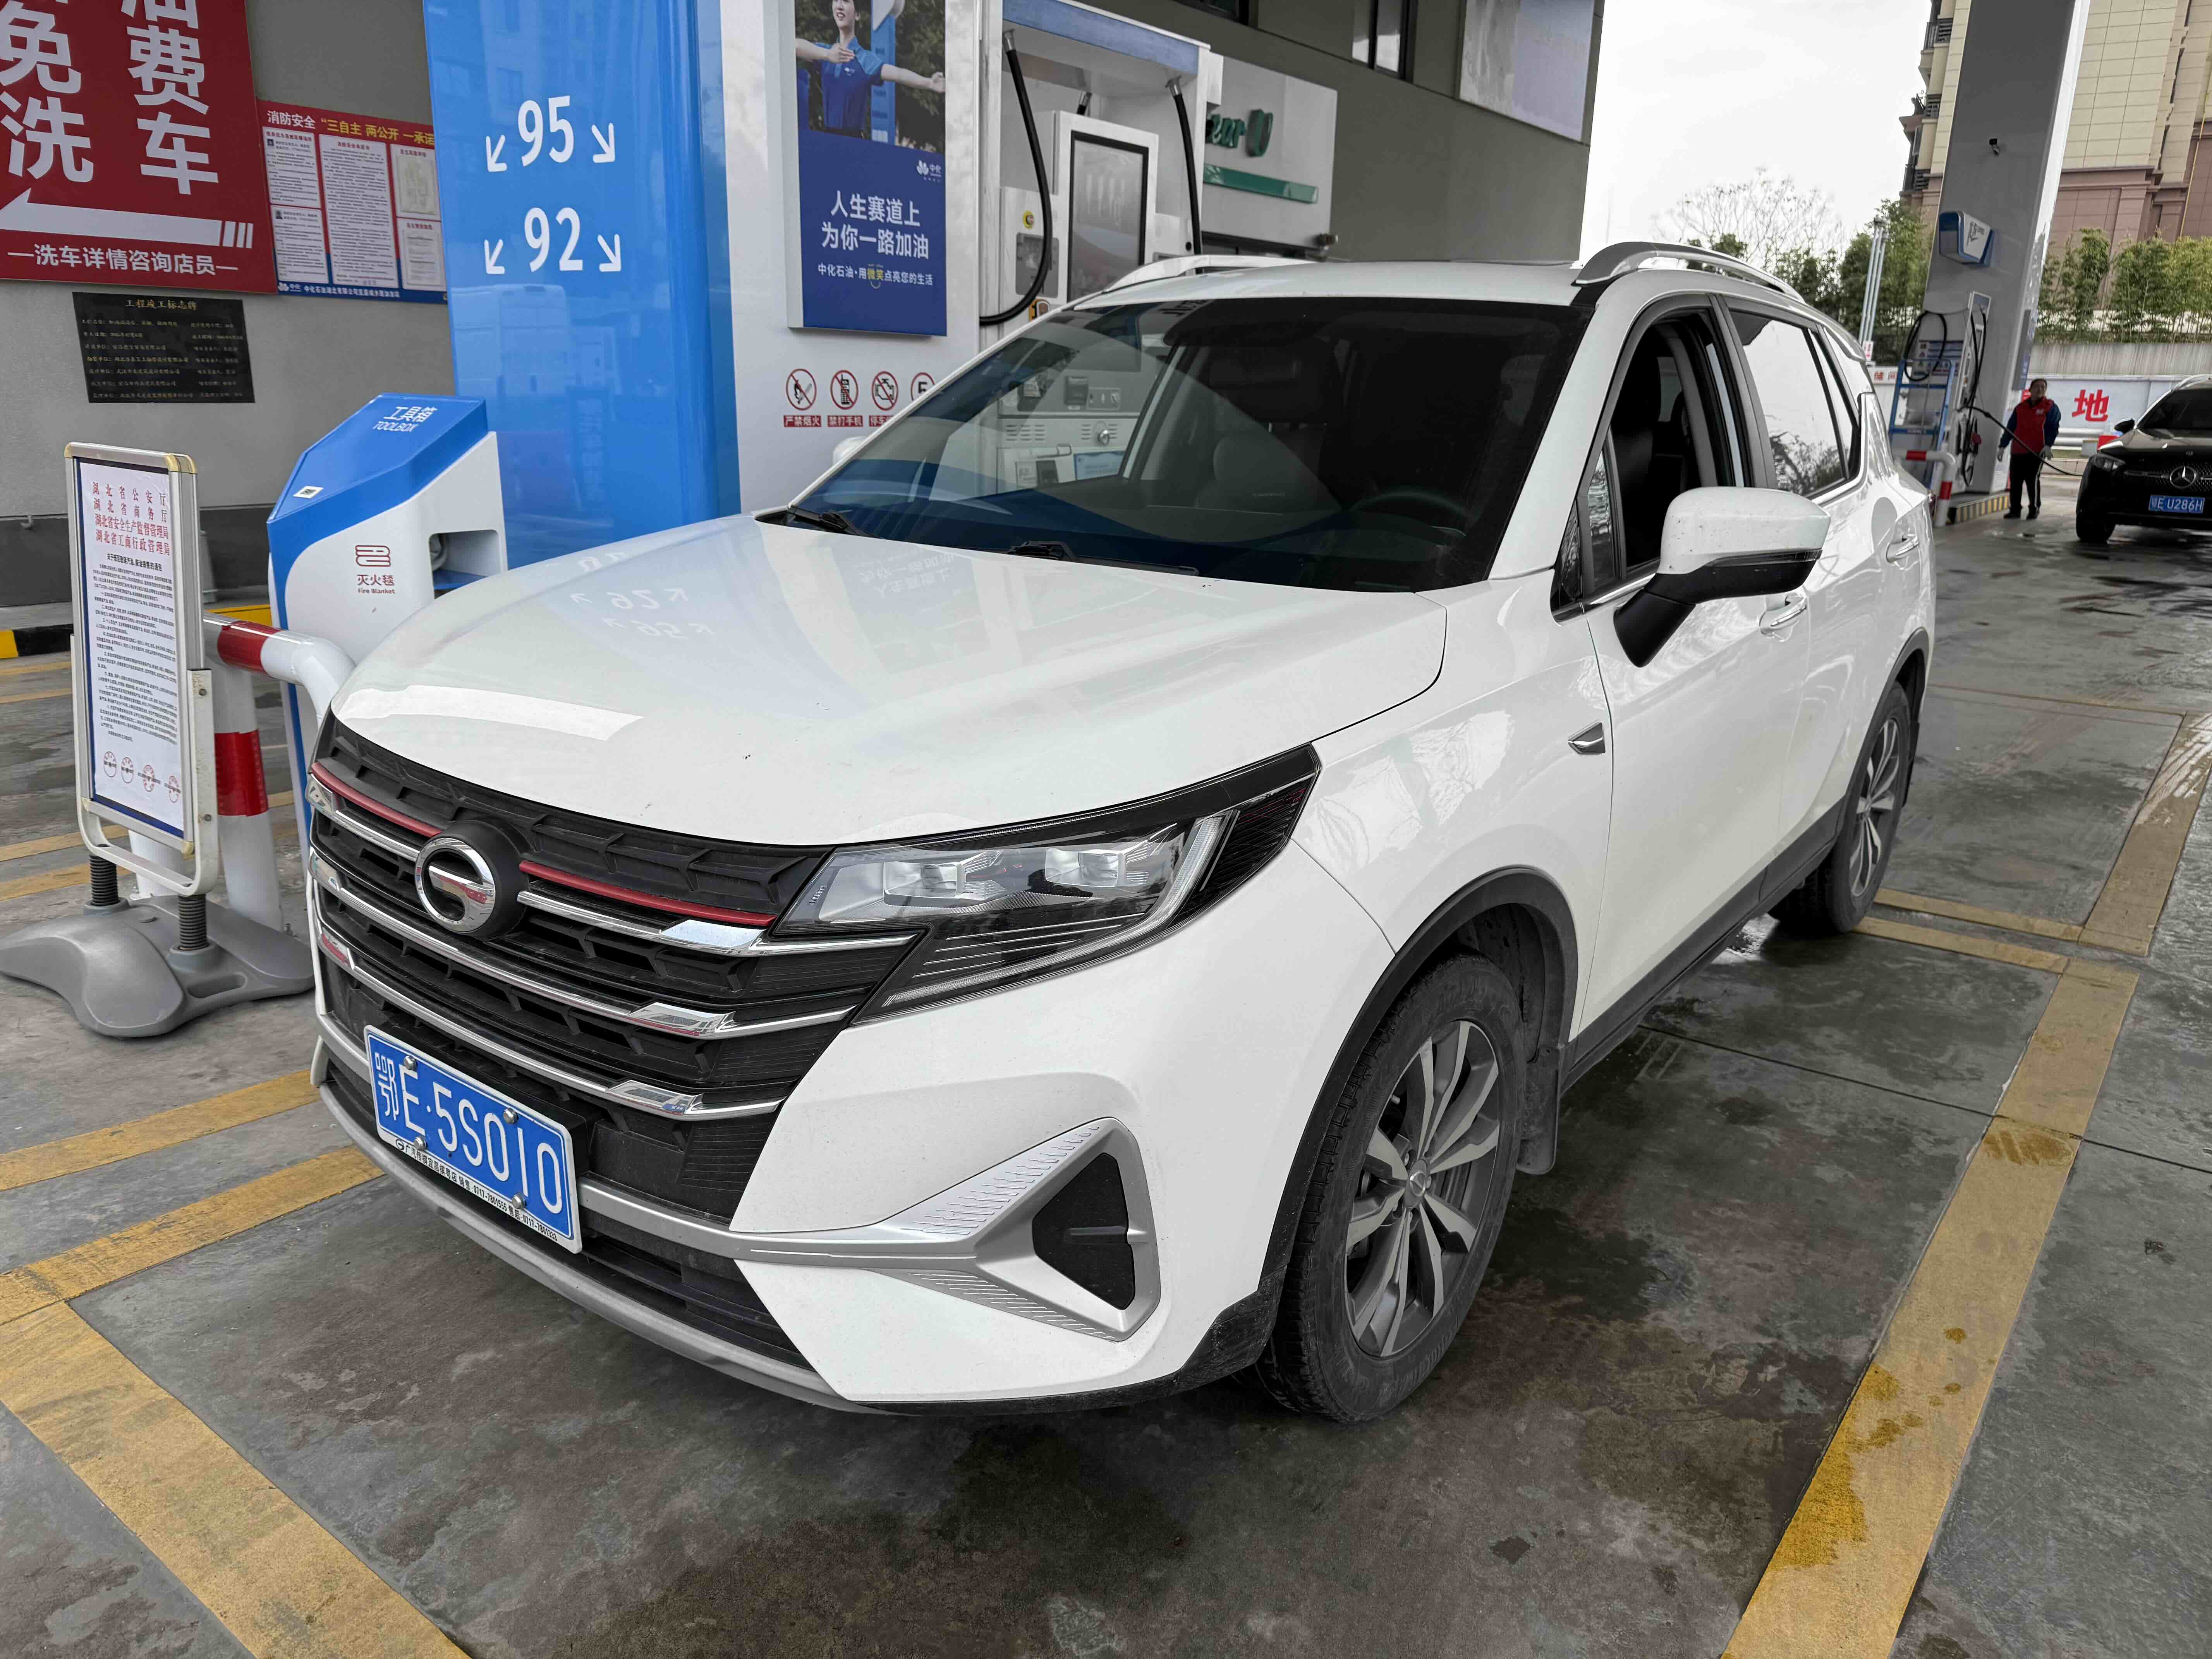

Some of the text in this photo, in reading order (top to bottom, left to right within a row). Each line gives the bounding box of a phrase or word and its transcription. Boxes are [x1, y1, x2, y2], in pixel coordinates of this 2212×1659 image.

[267, 110, 316, 129] 消防安全
[365, 124, 399, 140] 两公开
[518, 96, 574, 167] 95
[0, 91, 218, 195] 洗车
[831, 190, 920, 227] 人生赛道上
[524, 207, 583, 272] 92
[821, 222, 929, 259] 为你一路加油
[383, 406, 438, 422] 工具箱
[2071, 389, 2109, 422] 地
[372, 421, 419, 432] TOOLBOX
[785, 416, 820, 426] 严禁烟火
[829, 416, 863, 426] 禁打手机
[93, 481, 167, 506] 湖北省公安厅
[94, 498, 168, 523] 湖北省商务厅
[95, 514, 169, 540] 湖北省安全生产监督管理局
[96, 529, 170, 556] 湖北省工商行政管理局
[357, 574, 395, 586] 灭火毯
